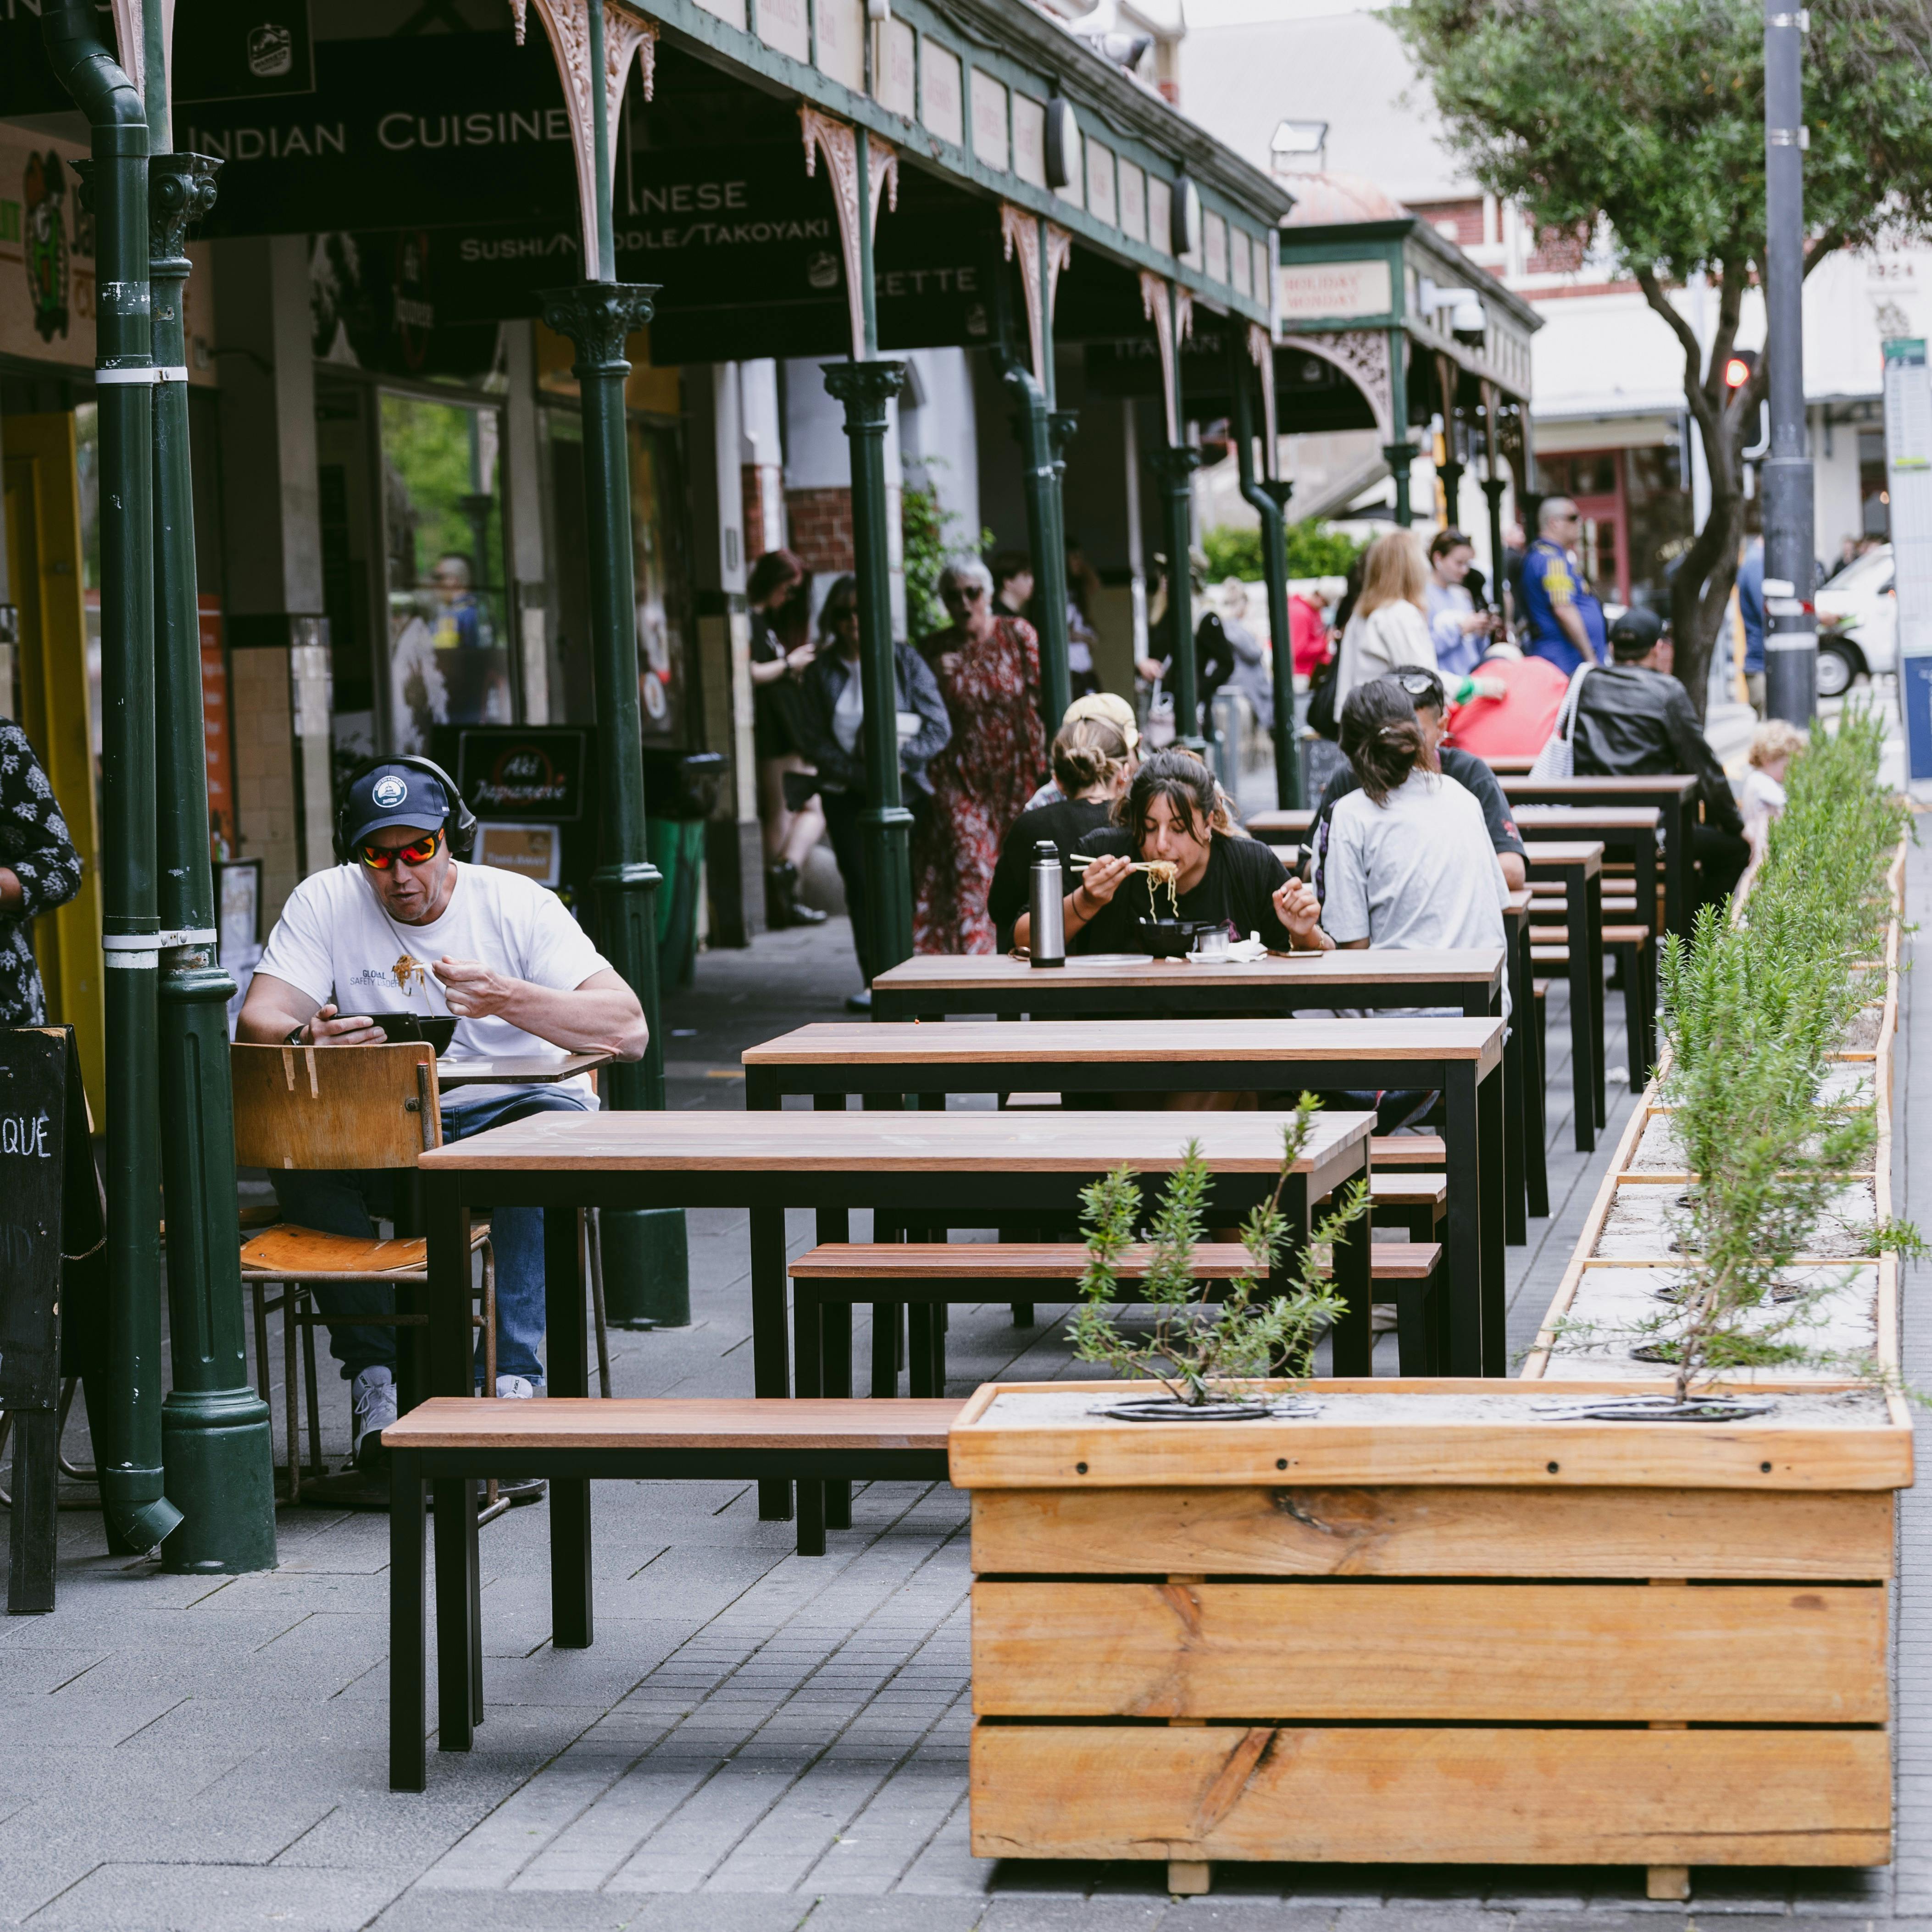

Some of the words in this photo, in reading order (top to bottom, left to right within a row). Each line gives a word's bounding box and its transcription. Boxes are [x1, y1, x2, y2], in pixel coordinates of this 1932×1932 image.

[187, 122, 345, 161] INDIAN
[378, 110, 572, 150] CUISINE
[1114, 333, 1220, 360] ITAAN
[350, 977, 375, 986] SAFETY
[0, 1116, 51, 1158] QUE
